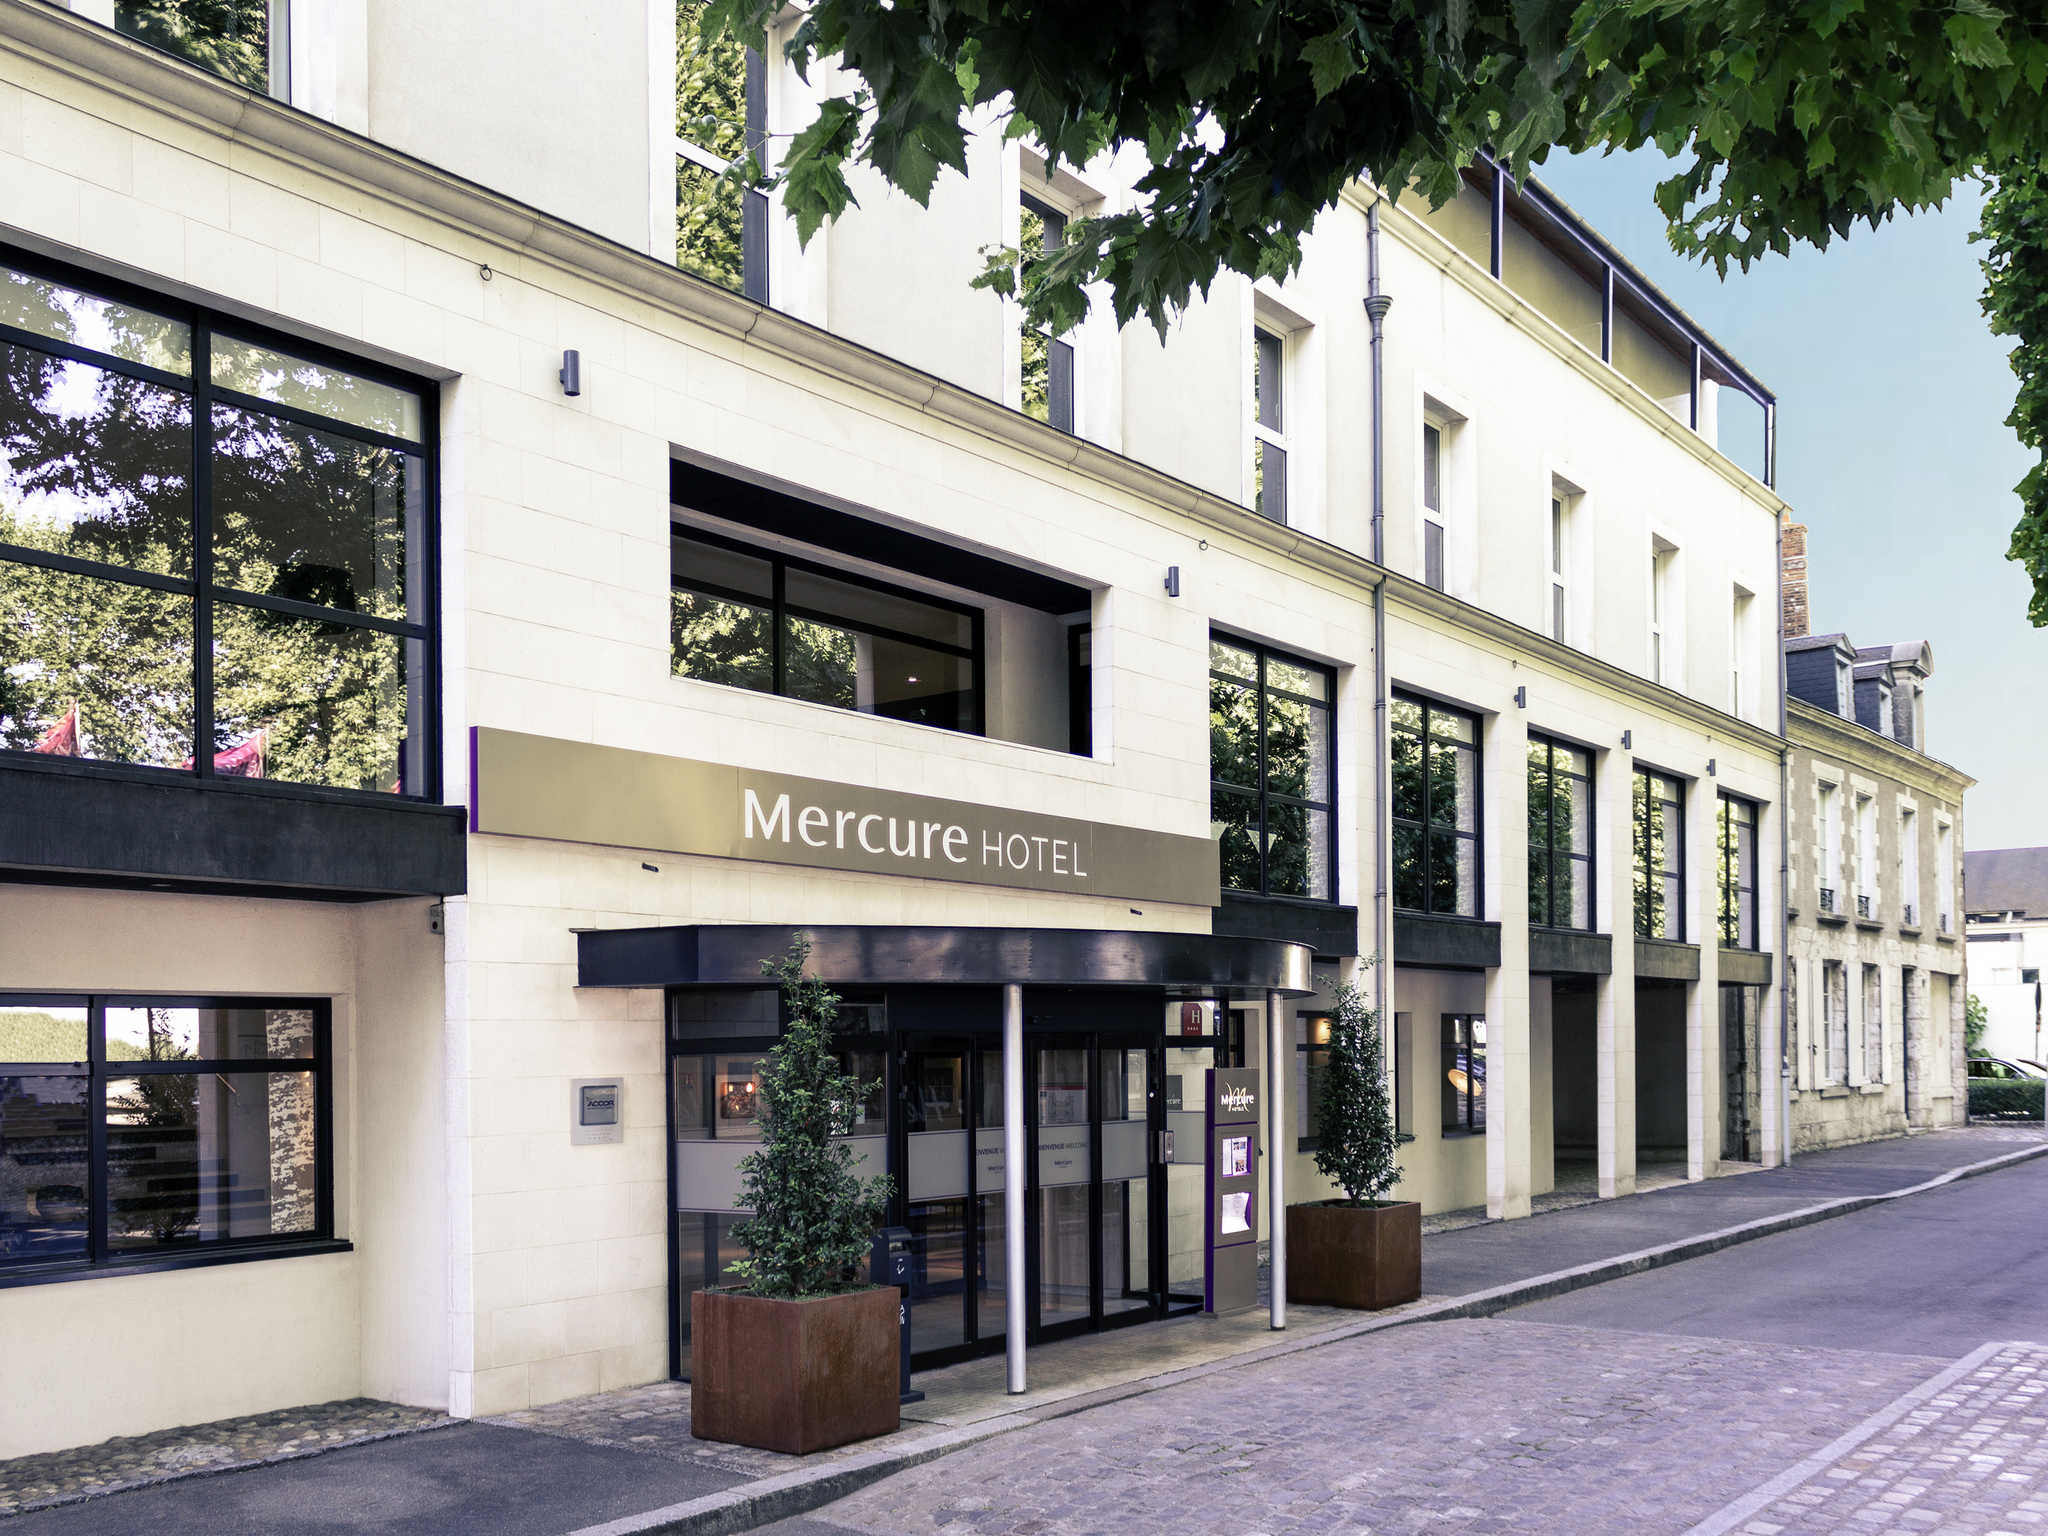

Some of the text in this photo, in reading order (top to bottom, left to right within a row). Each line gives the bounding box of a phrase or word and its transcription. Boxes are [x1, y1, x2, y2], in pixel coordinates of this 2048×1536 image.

[744, 789, 1087, 876] Mercure HOTEL
[1192, 1010, 1200, 1023] H
[1221, 1094, 1254, 1104] Mercure
